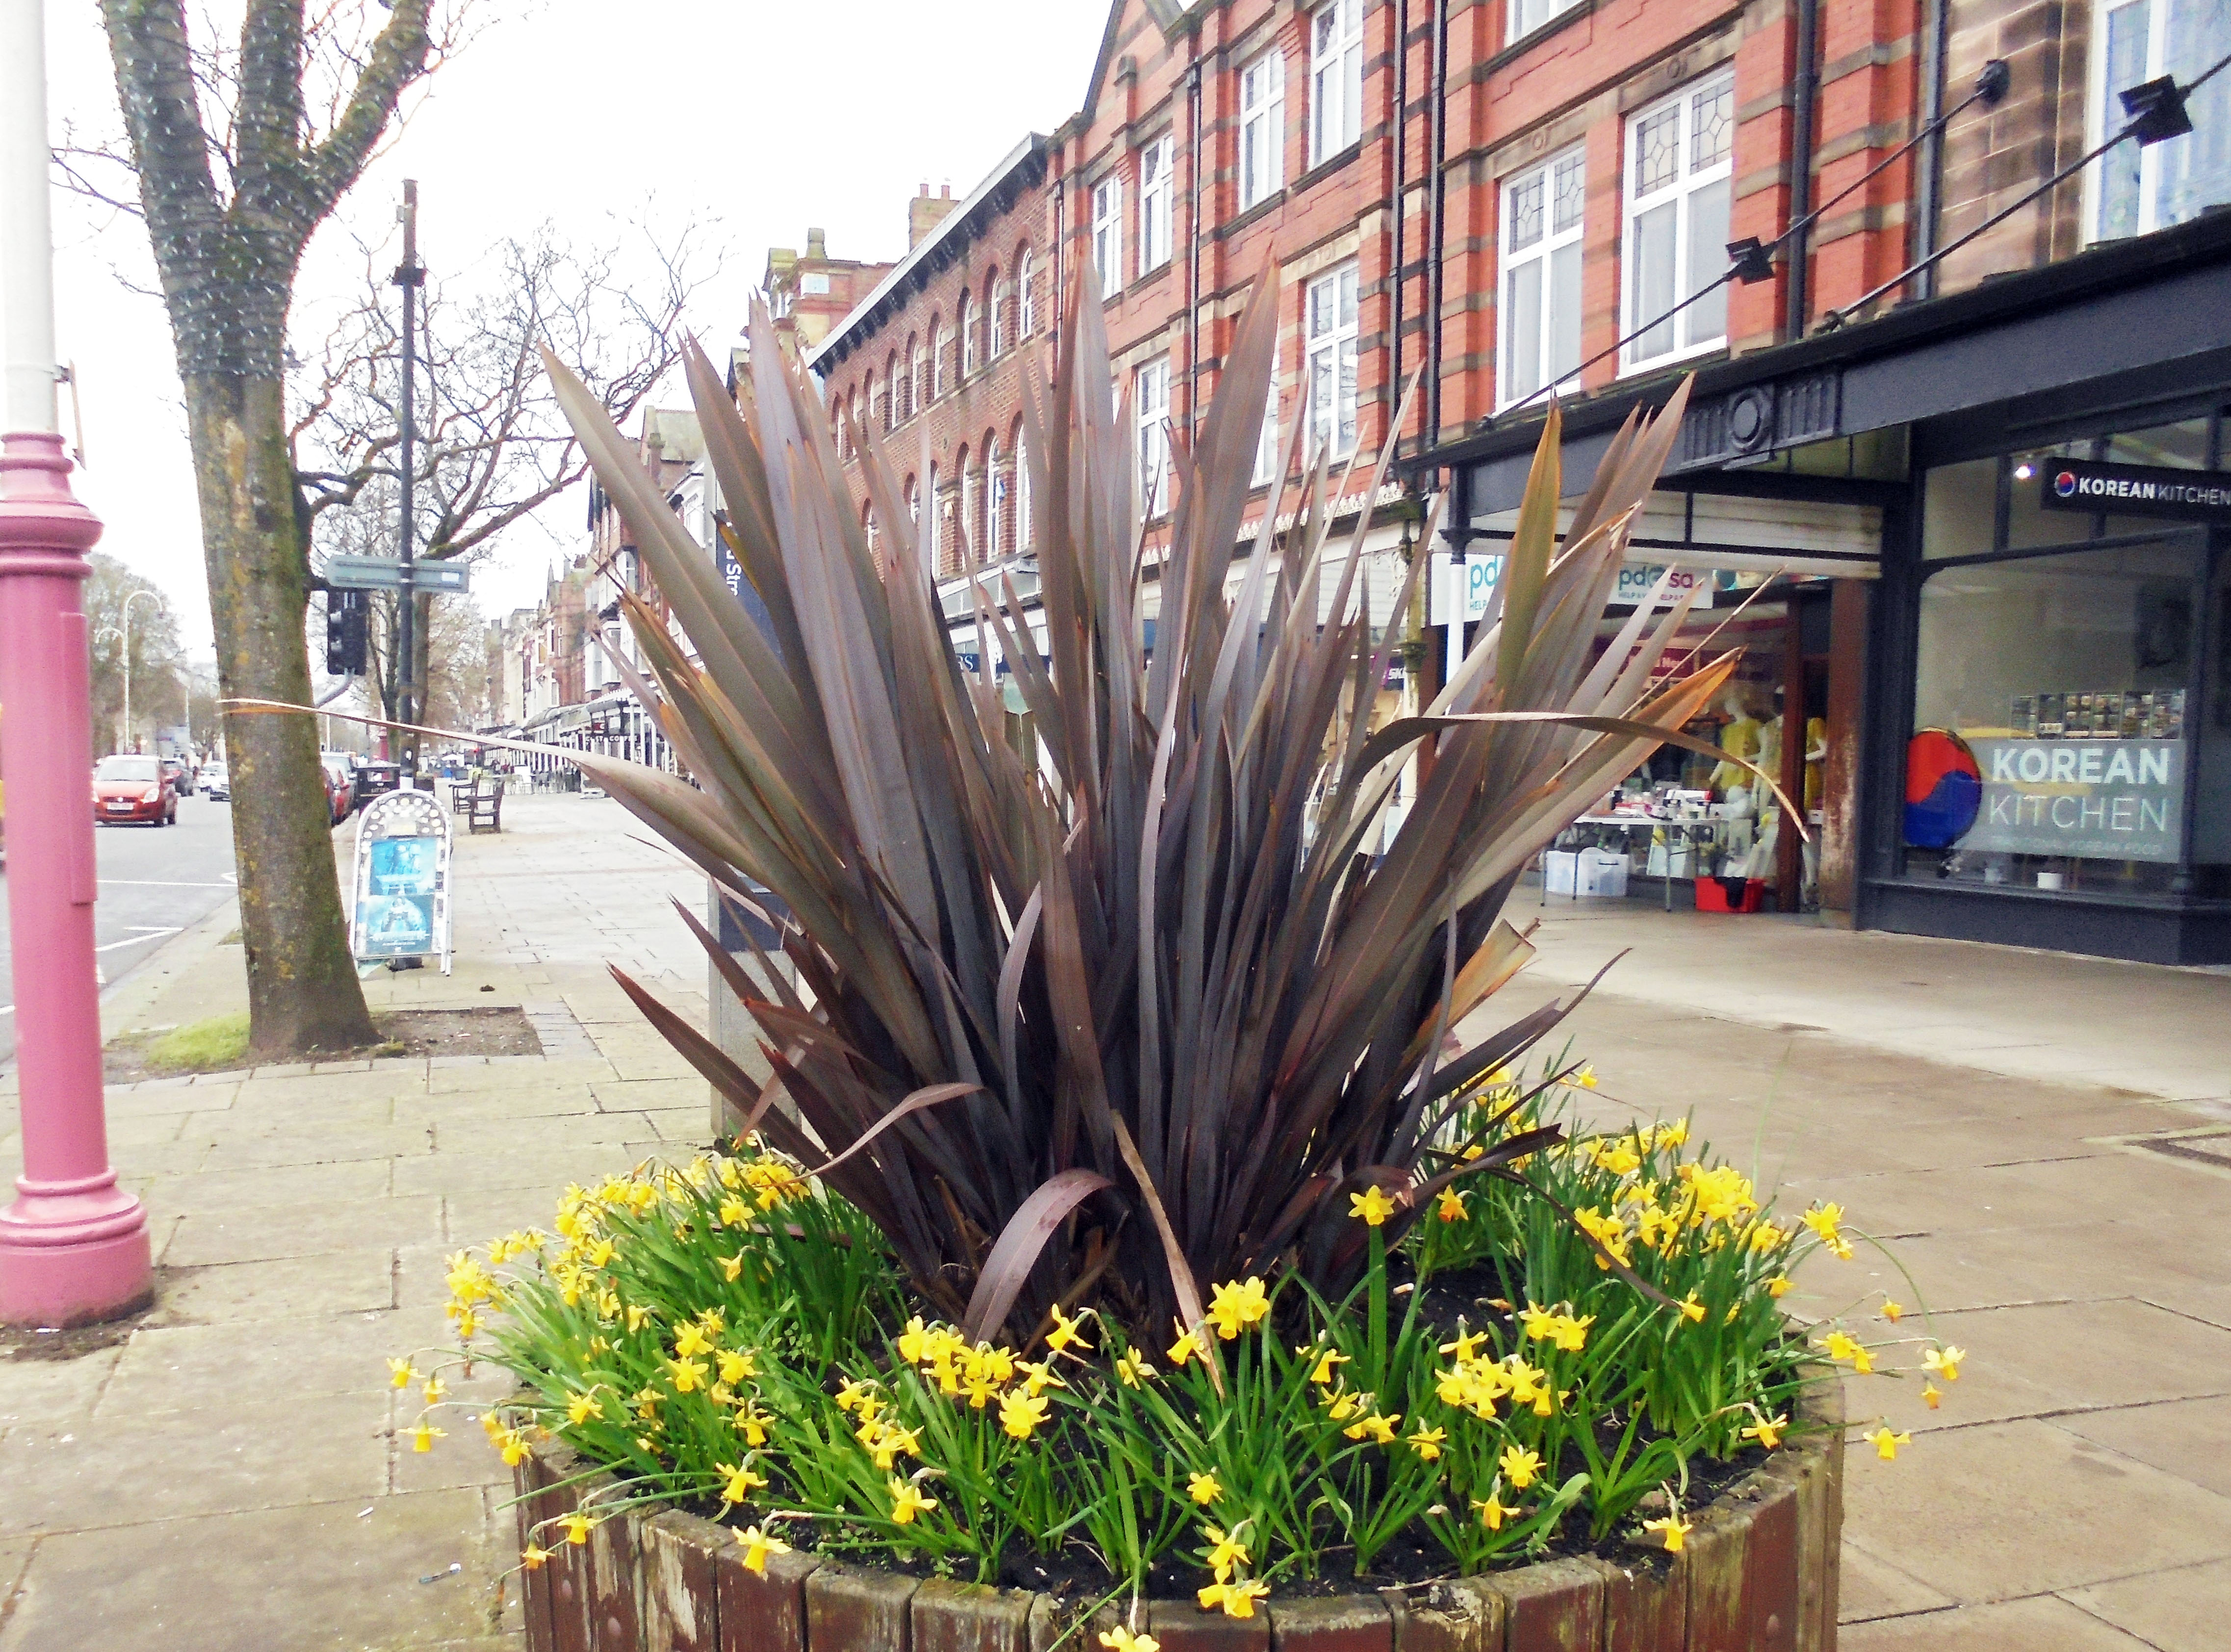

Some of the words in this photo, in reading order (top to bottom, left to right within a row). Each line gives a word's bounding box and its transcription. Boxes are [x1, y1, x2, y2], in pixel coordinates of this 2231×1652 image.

[2079, 477, 2155, 499] KOREAN
[2158, 485, 2231, 506] KITCHEN
[1992, 747, 2169, 785] KOREAN
[1990, 795, 2168, 832] KITCHEN
